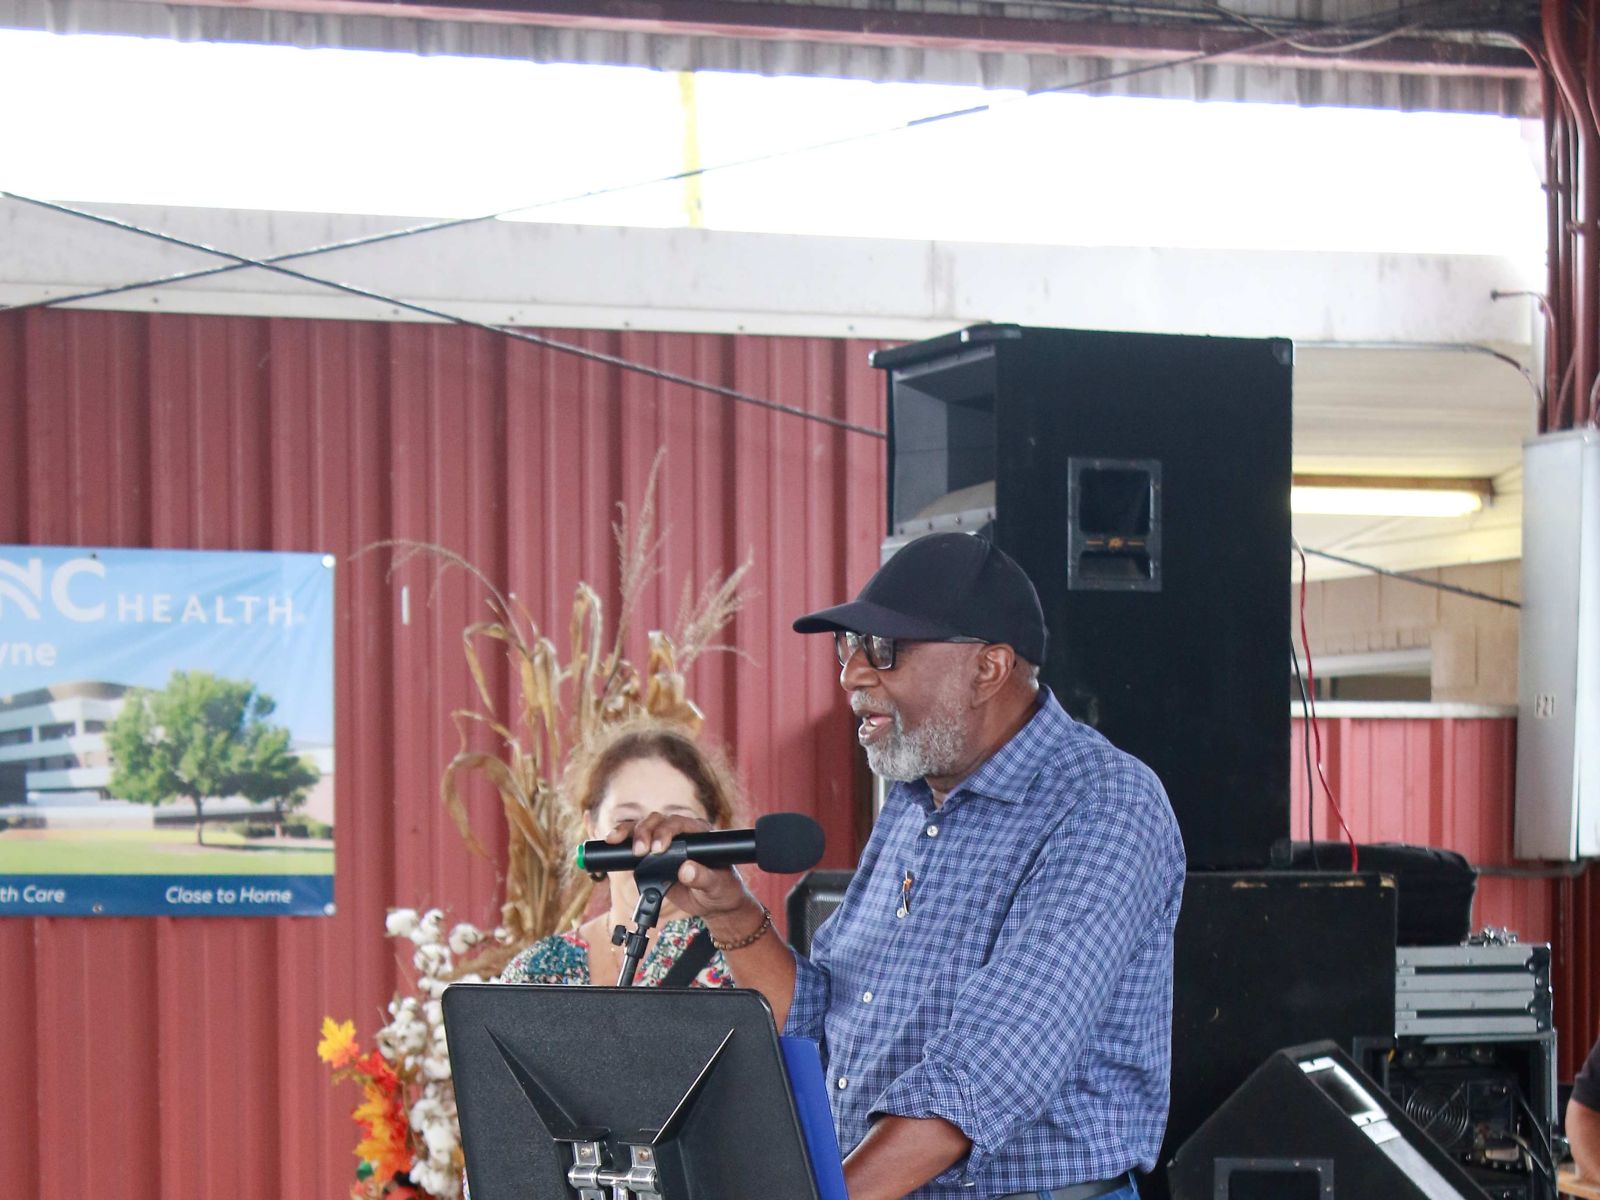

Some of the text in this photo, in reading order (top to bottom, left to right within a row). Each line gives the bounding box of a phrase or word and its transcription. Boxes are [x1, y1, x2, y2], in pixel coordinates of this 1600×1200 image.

[117, 592, 294, 625] HEALTH
[23, 885, 65, 903] Care
[165, 886, 292, 904] Close to Home
